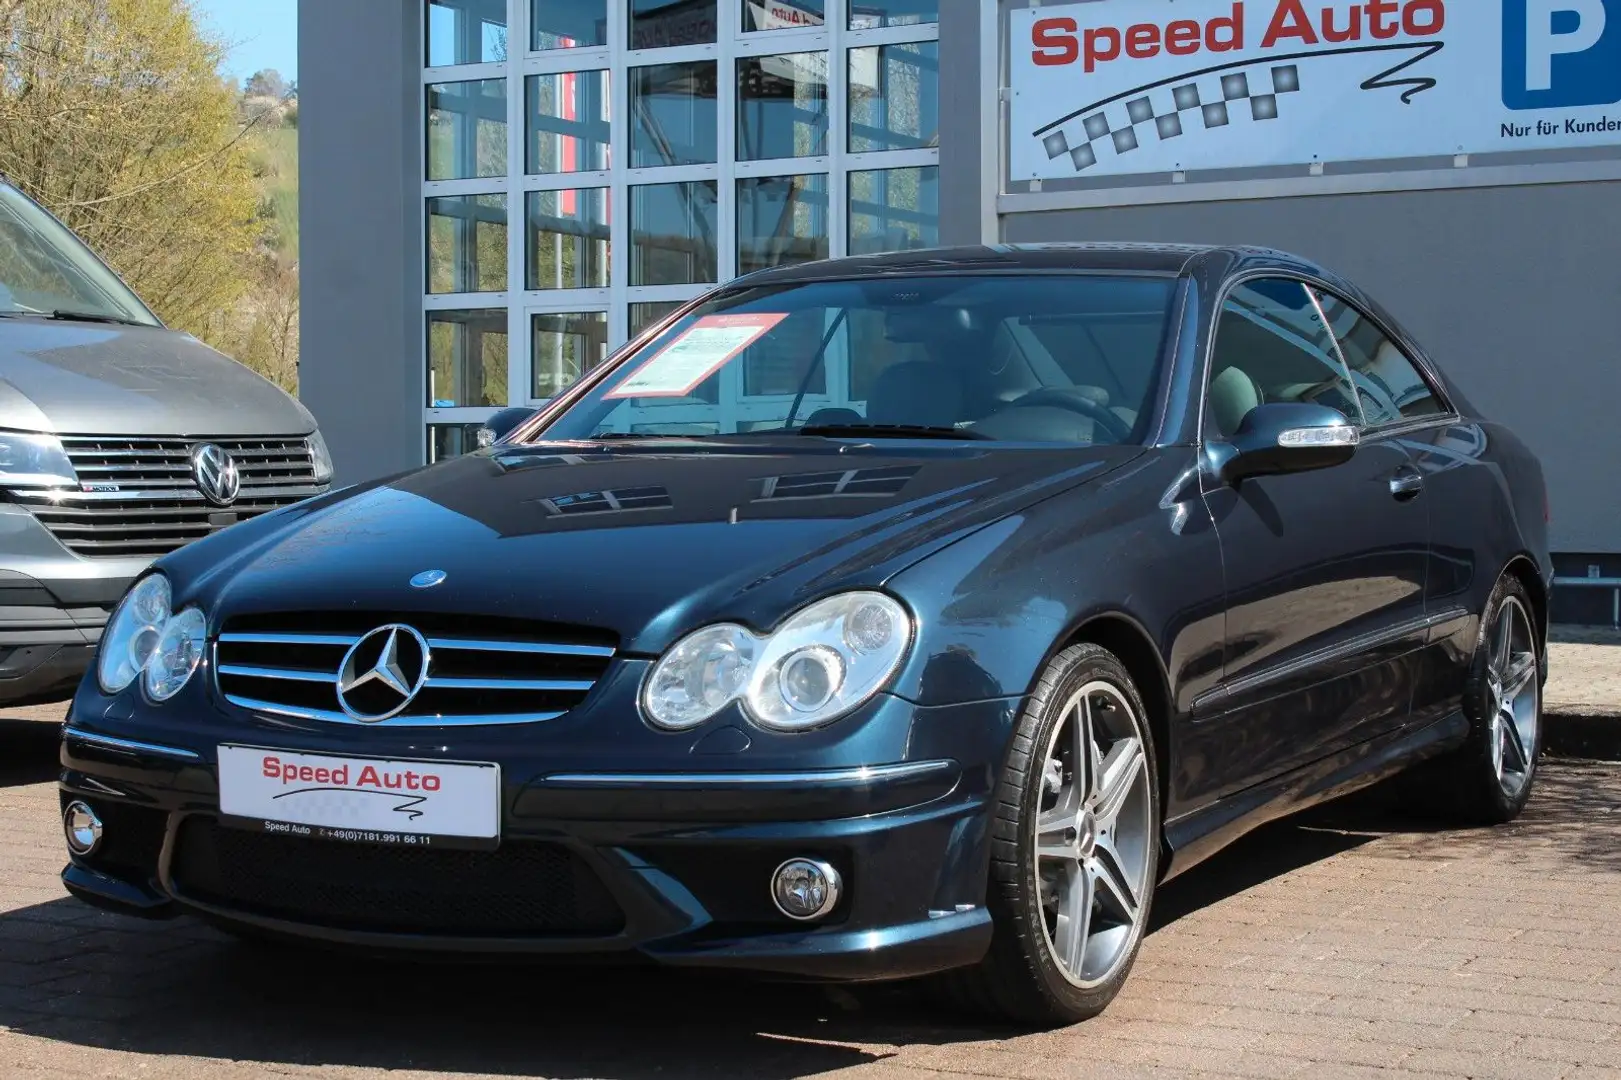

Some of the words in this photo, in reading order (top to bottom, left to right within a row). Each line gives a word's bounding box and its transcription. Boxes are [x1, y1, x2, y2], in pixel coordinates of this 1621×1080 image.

[1031, 2, 1244, 73] Speed
[1260, 0, 1445, 48] Auto
[1525, 0, 1606, 91] P
[1500, 122, 1531, 137] Nur
[1536, 120, 1559, 136] für
[262, 756, 349, 785] Speed
[356, 765, 441, 791] Auto
[264, 821, 290, 832] Speed
[291, 825, 311, 835] Auto
[404, 835, 417, 844] 66
[420, 836, 431, 845] 11
